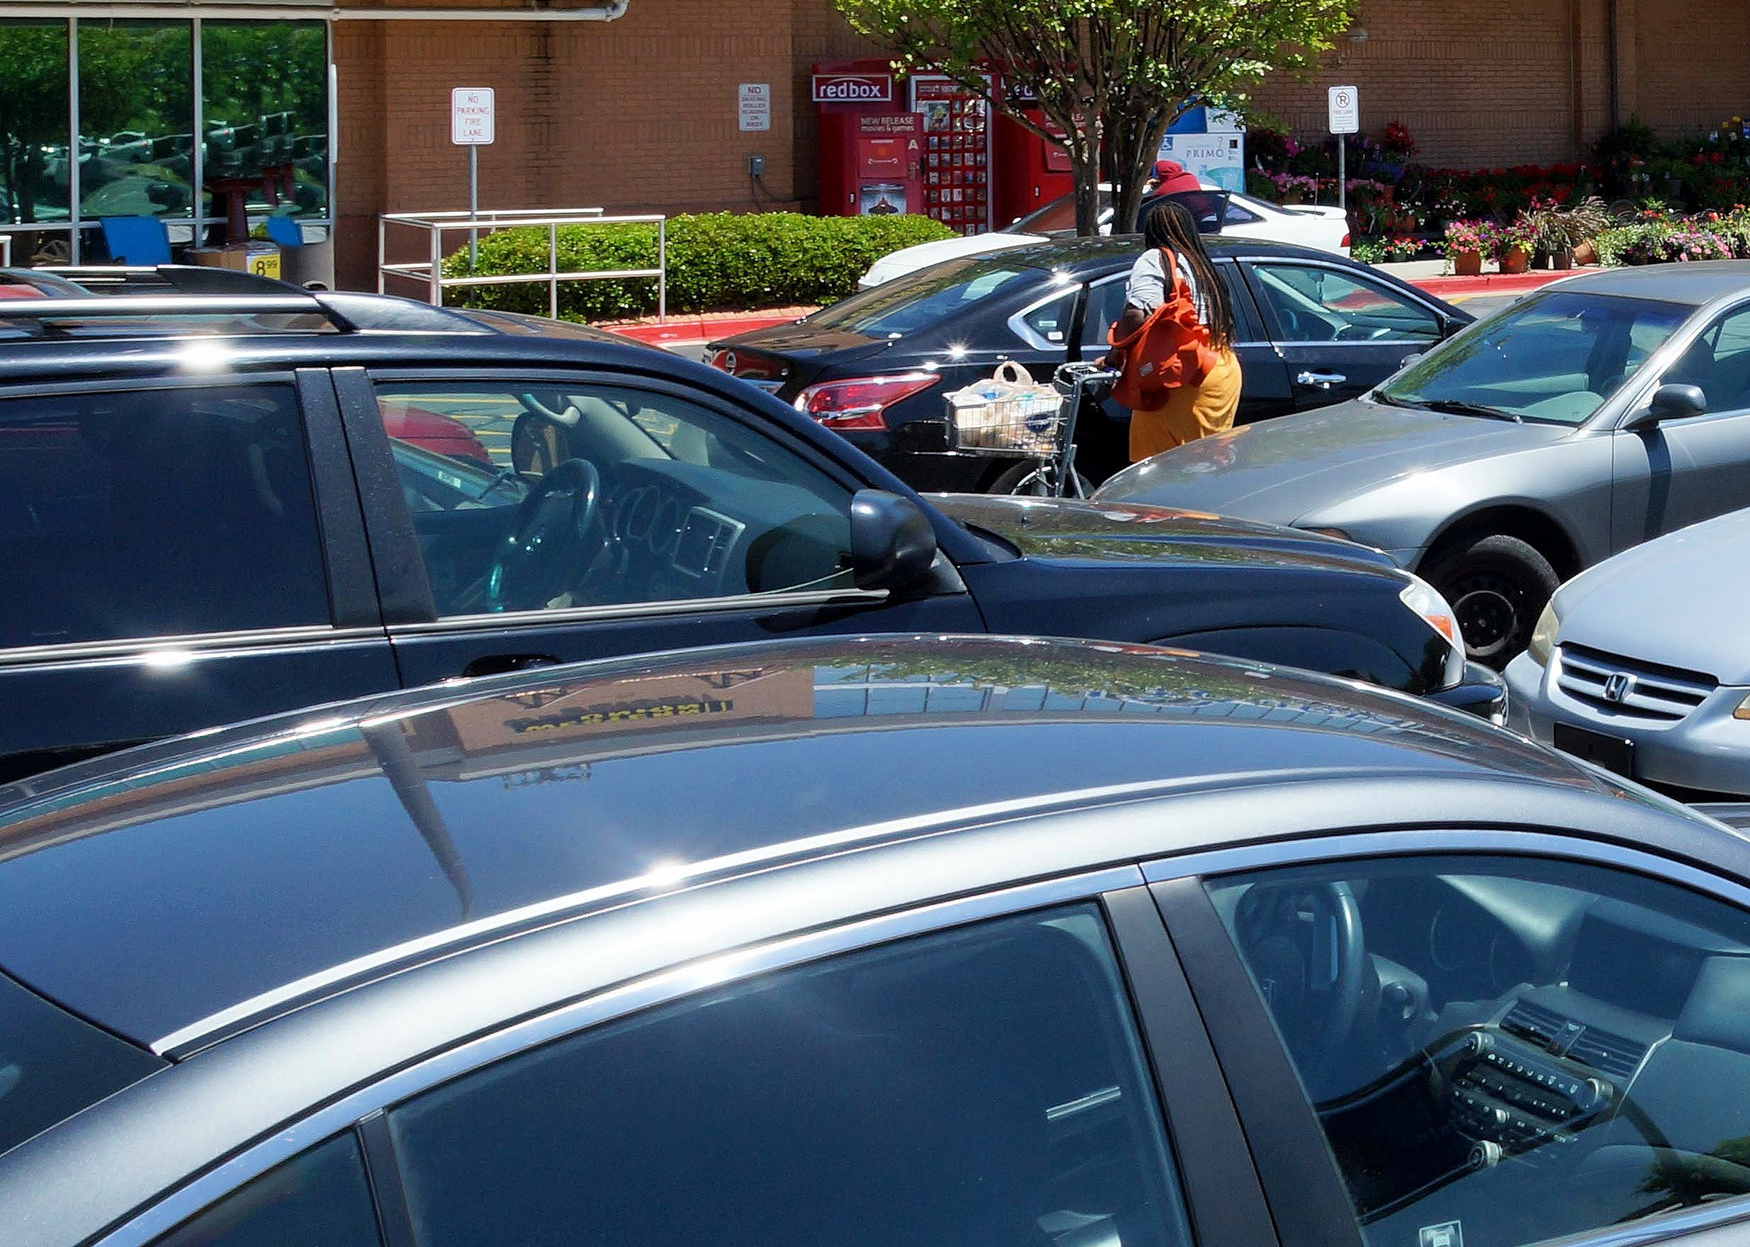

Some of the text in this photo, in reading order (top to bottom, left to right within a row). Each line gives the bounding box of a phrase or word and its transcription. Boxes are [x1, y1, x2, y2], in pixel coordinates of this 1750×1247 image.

[820, 82, 881, 97] redbox
[456, 107, 490, 115] PARKING
[861, 116, 914, 125] NEW RELEASE
[908, 139, 919, 150] A
[1186, 149, 1224, 158] PRIMO
